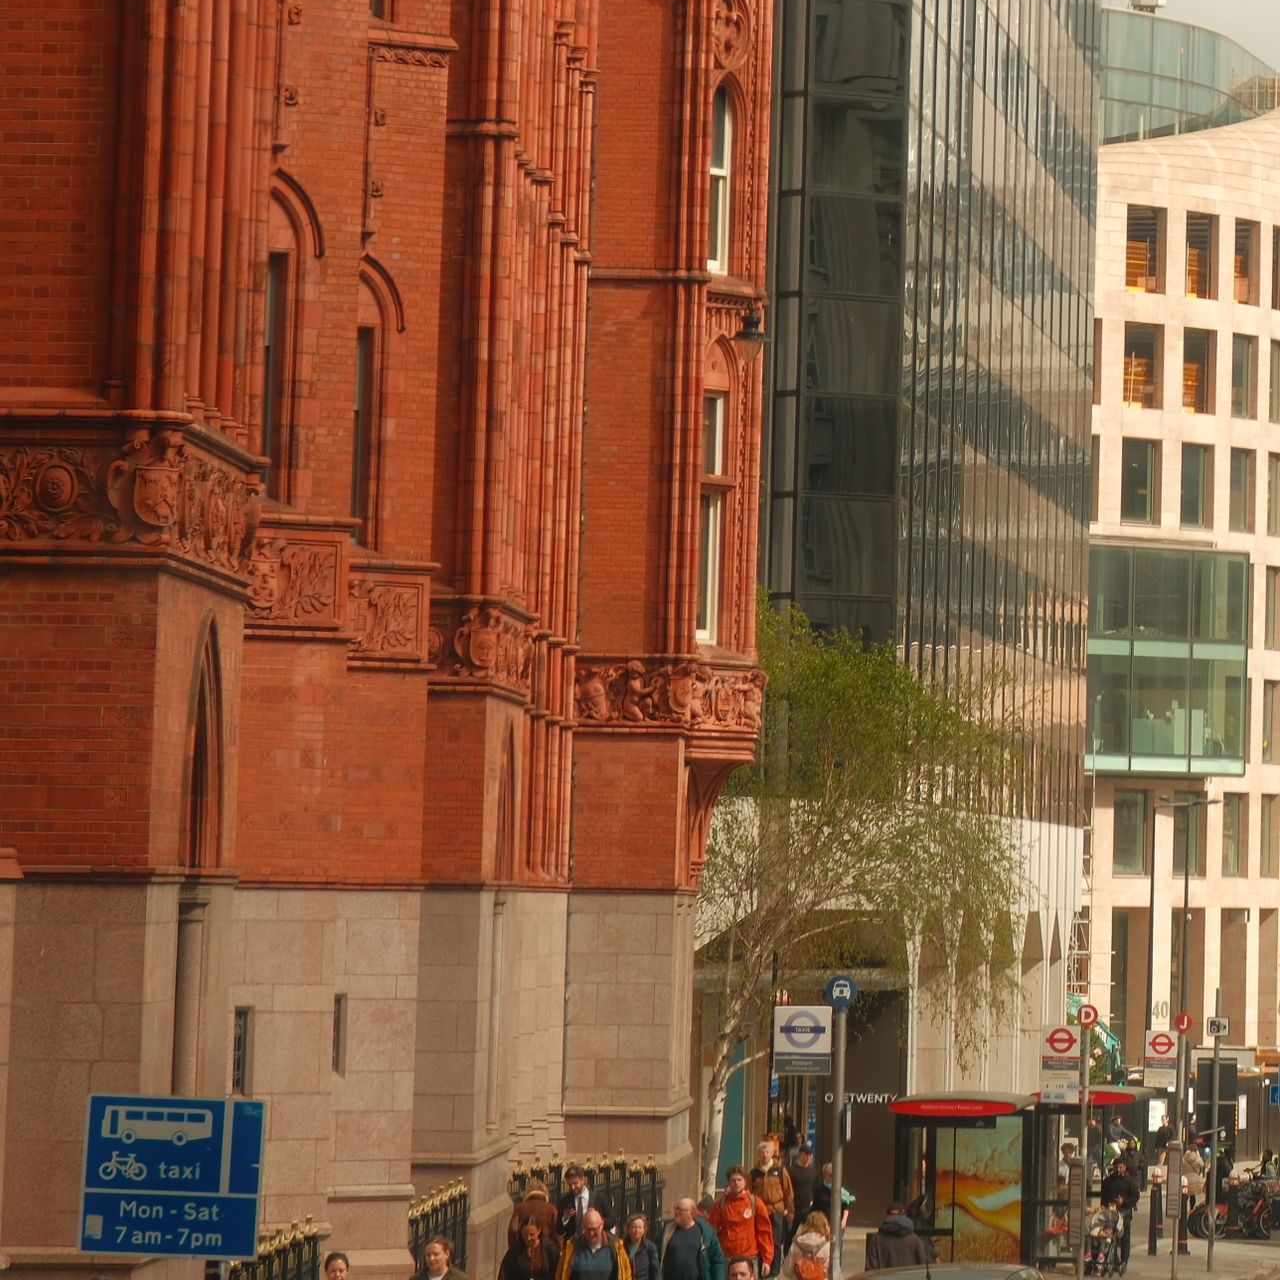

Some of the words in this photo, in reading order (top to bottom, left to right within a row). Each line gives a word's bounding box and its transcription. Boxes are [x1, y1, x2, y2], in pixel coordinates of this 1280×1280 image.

[1081, 1007, 1095, 1024] D
[1152, 1001, 1169, 1020] 40
[1179, 1015, 1188, 1029] J
[824, 1092, 898, 1104] OETWENTY
[158, 1161, 201, 1180] taxi
[119, 1200, 163, 1218] Mon
[183, 1202, 220, 1221] Sat
